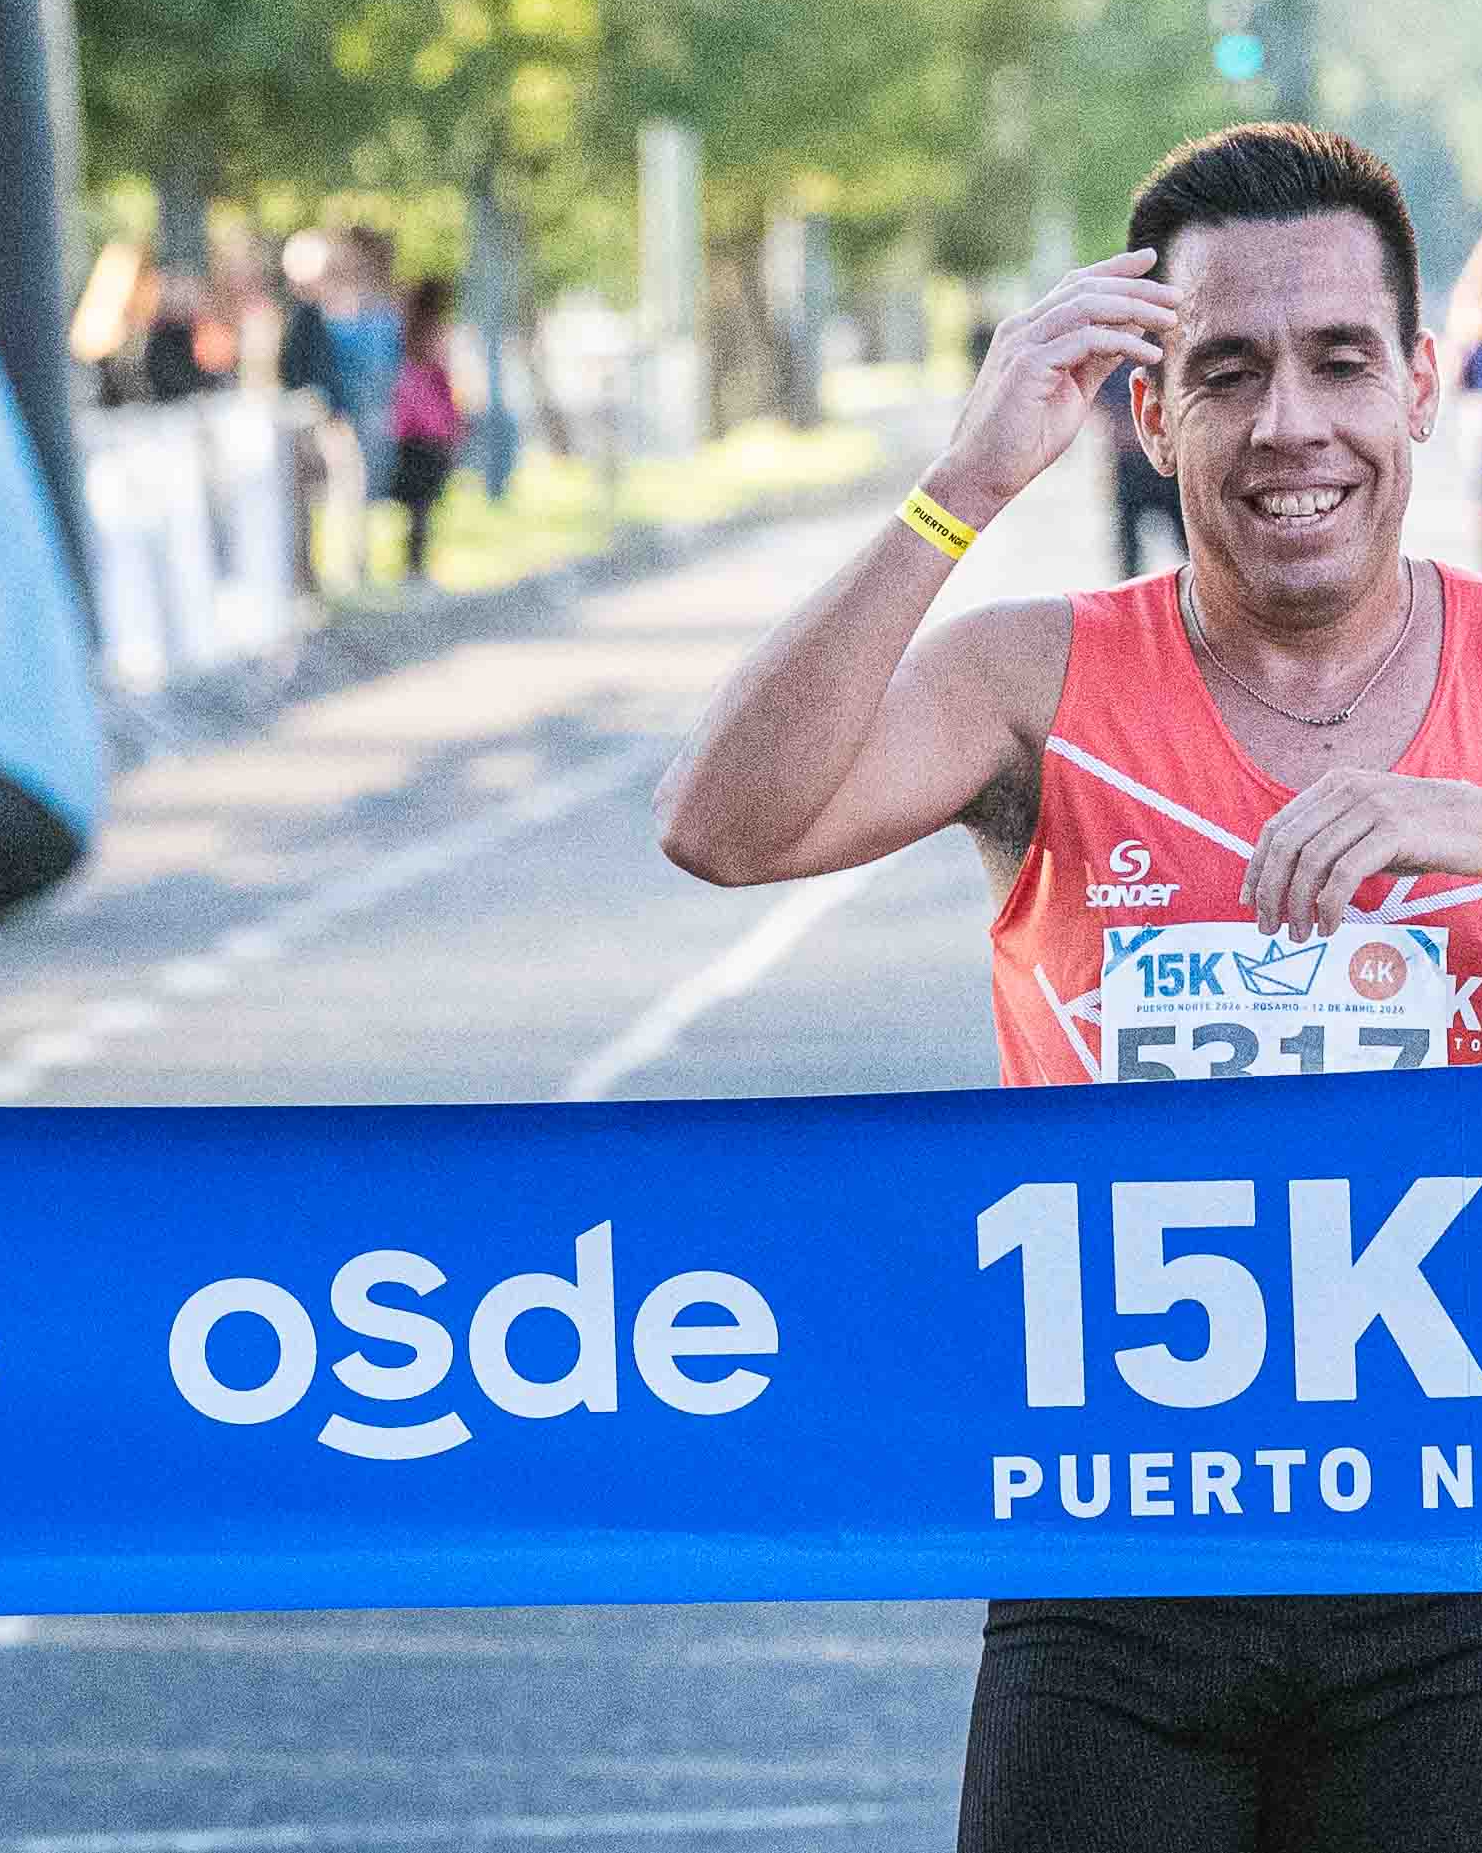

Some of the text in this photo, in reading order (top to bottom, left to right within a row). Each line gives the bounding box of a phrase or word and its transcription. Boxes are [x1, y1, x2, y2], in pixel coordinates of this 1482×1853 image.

[913, 507, 949, 537] PUERTO
[1136, 952, 1225, 998] 15K
[1358, 962, 1397, 985] 4K
[1136, 1003, 1175, 1013] PUERTO
[1253, 1002, 1299, 1013] ROSARIO
[1327, 1003, 1341, 1013] DE
[1344, 1003, 1376, 1014] ABRIL
[168, 1219, 780, 1426] osde
[992, 1447, 1373, 1519] PUERTO
